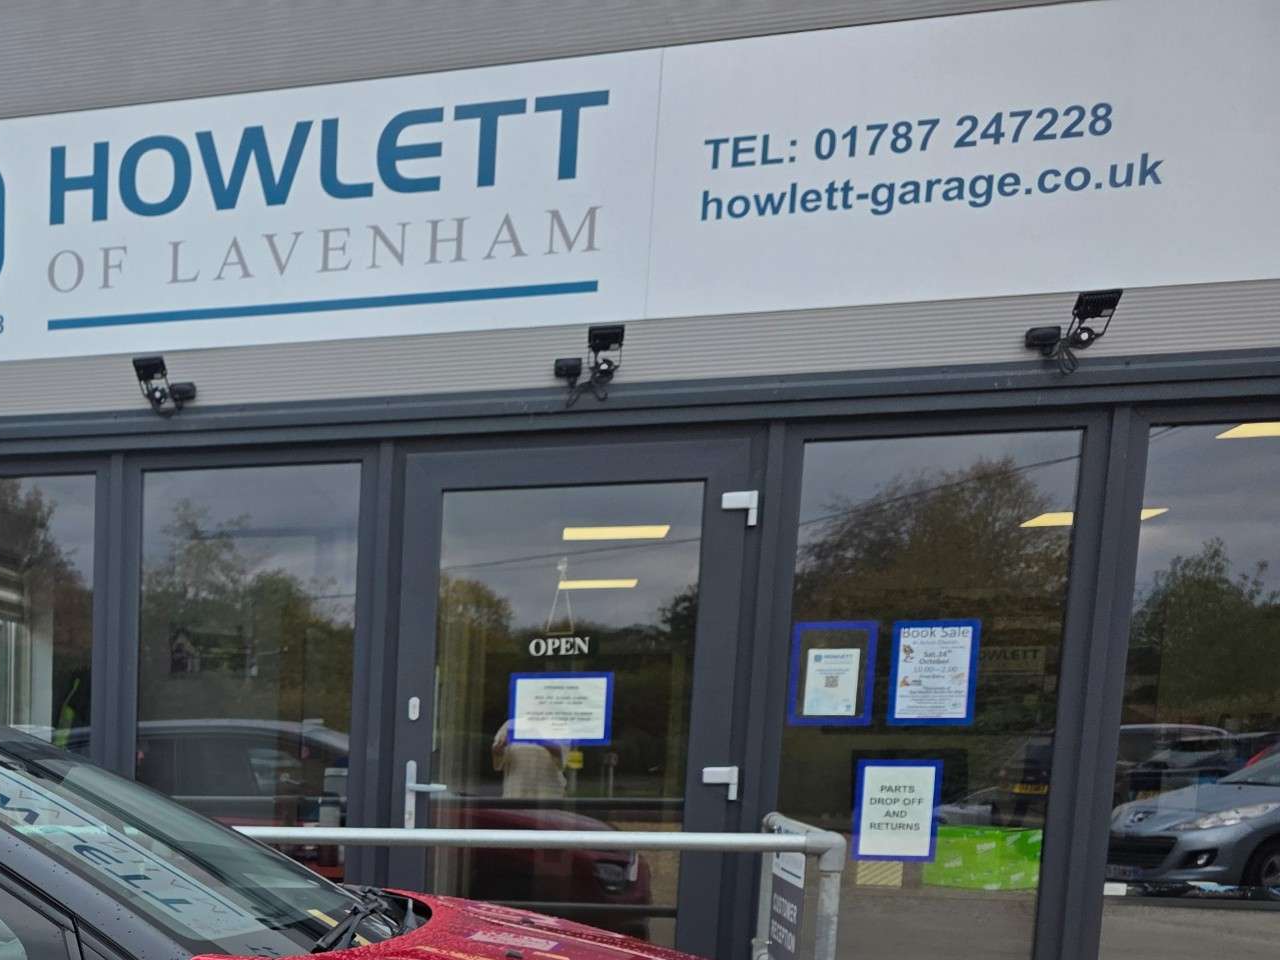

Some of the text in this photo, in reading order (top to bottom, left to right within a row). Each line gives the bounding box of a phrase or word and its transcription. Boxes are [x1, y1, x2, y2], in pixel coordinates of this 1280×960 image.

[704, 102, 1114, 170] TEL: 01787 247228
[49, 89, 610, 225] HOWLETT
[700, 153, 1165, 221] howlett-garage.co.uk
[47, 205, 604, 293] OF LAVENHAM
[940, 626, 970, 639] Sale
[528, 636, 590, 656] OPEN
[978, 648, 1040, 661] OWLETT
[880, 784, 915, 794] PARTS
[870, 796, 924, 806] DROP OFF
[884, 809, 907, 819] AND
[870, 822, 920, 832] RETURNS
[772, 892, 798, 924] CUSTOMER
[771, 920, 795, 954] RECEPTION
